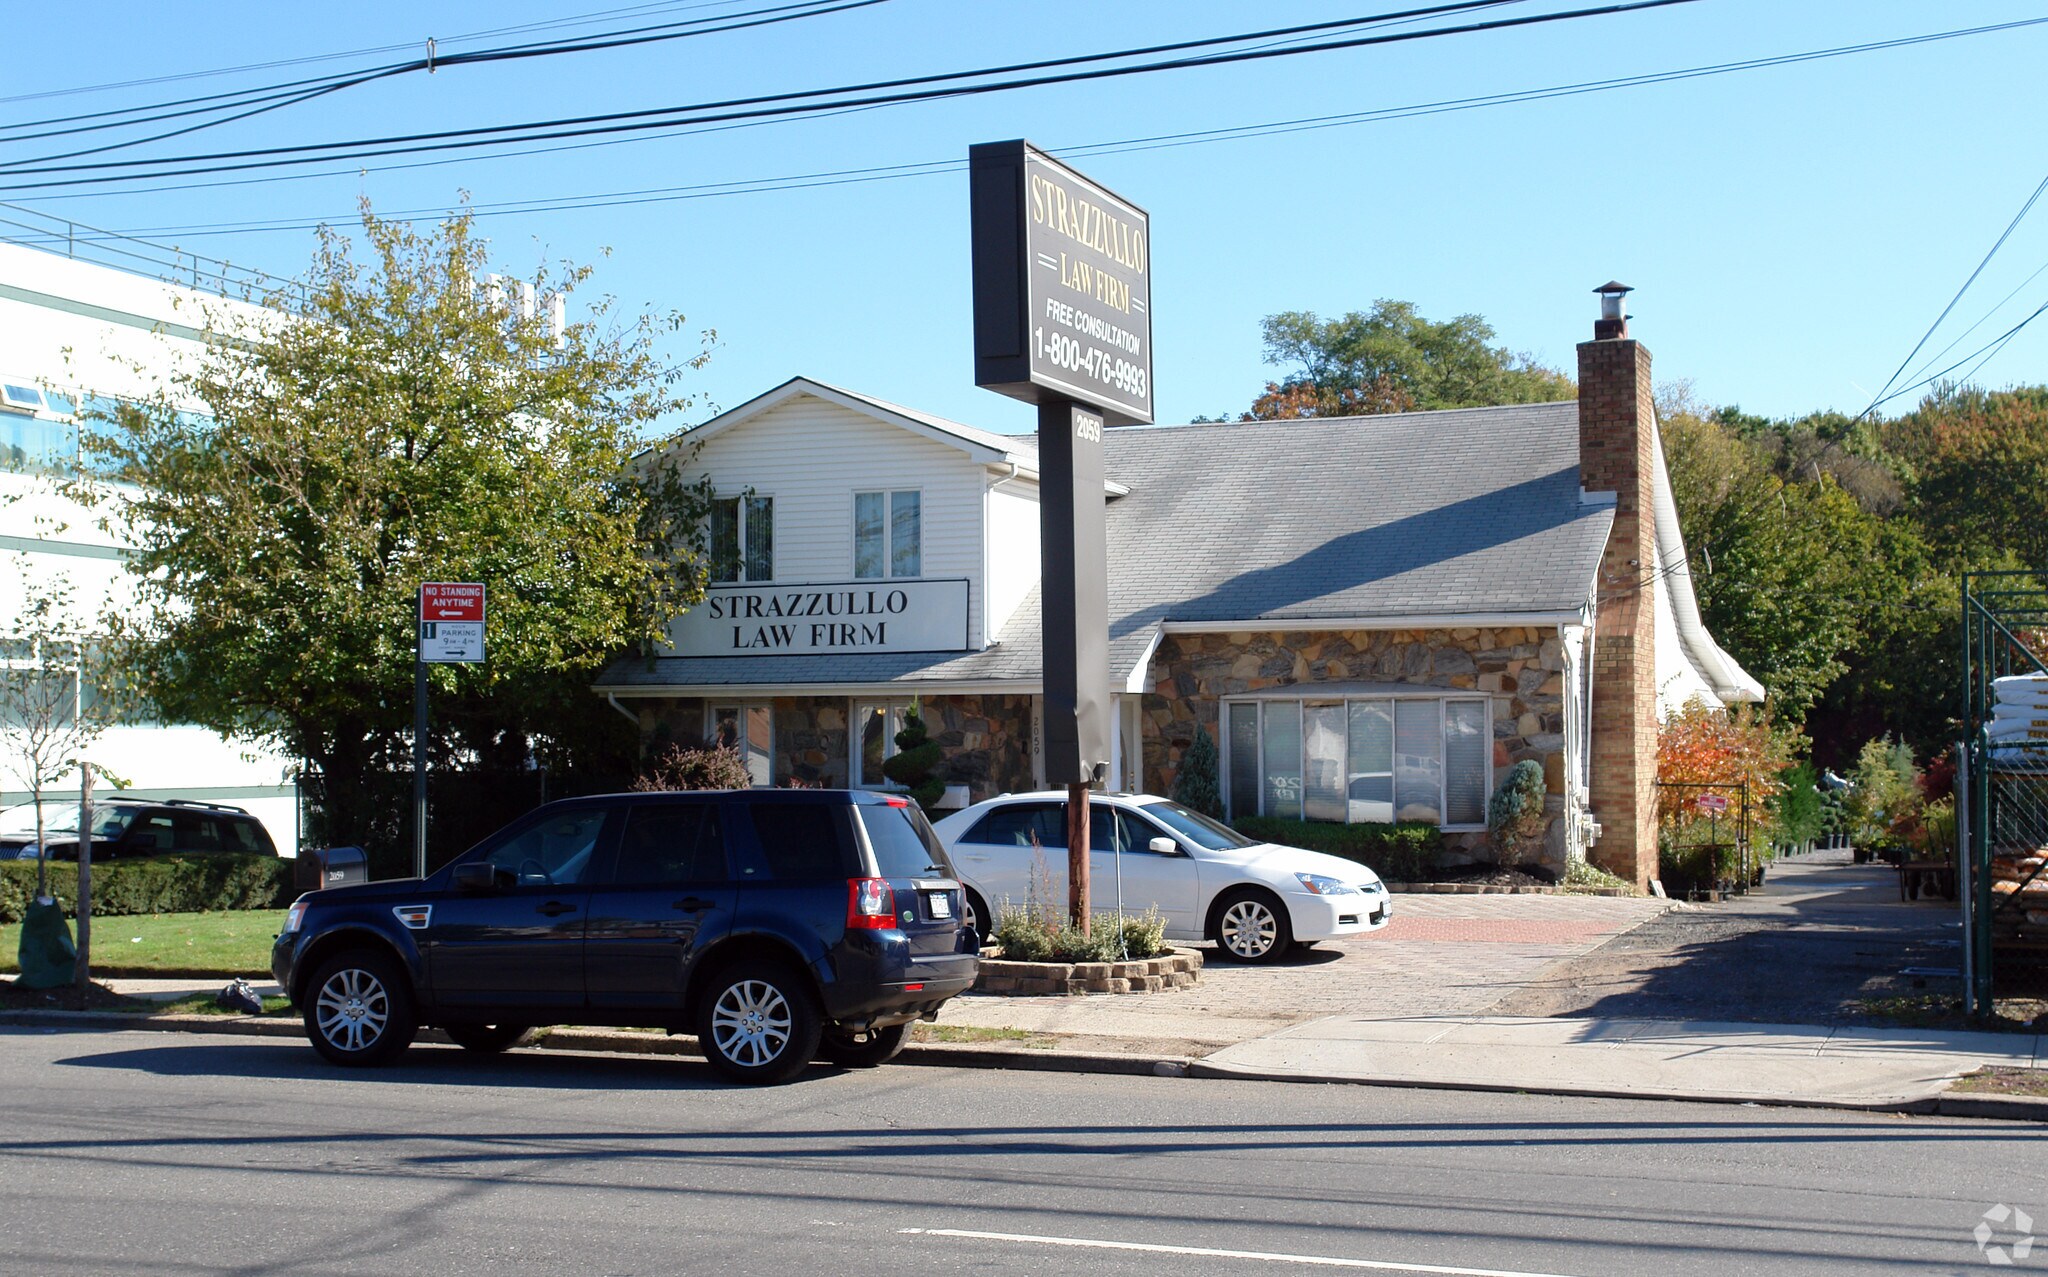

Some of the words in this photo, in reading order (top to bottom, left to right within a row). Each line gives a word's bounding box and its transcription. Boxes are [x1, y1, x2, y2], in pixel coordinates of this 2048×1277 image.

[1032, 174, 1145, 275] STRAZZULLO
[1060, 252, 1093, 294] LAW
[1096, 269, 1130, 314] FIRM
[1046, 298, 1073, 328] FREE
[1074, 310, 1141, 356] CONSULTATION
[1035, 326, 1147, 398] 1-800-476-9993
[1076, 414, 1101, 444] 2059
[425, 587, 437, 596] NO
[441, 587, 480, 597] STANDING
[432, 598, 474, 607] ANYTIME
[709, 590, 908, 620] STRAZZULLO
[732, 624, 797, 649] LAW
[810, 622, 887, 647] FIRM
[329, 870, 345, 881] 2059
